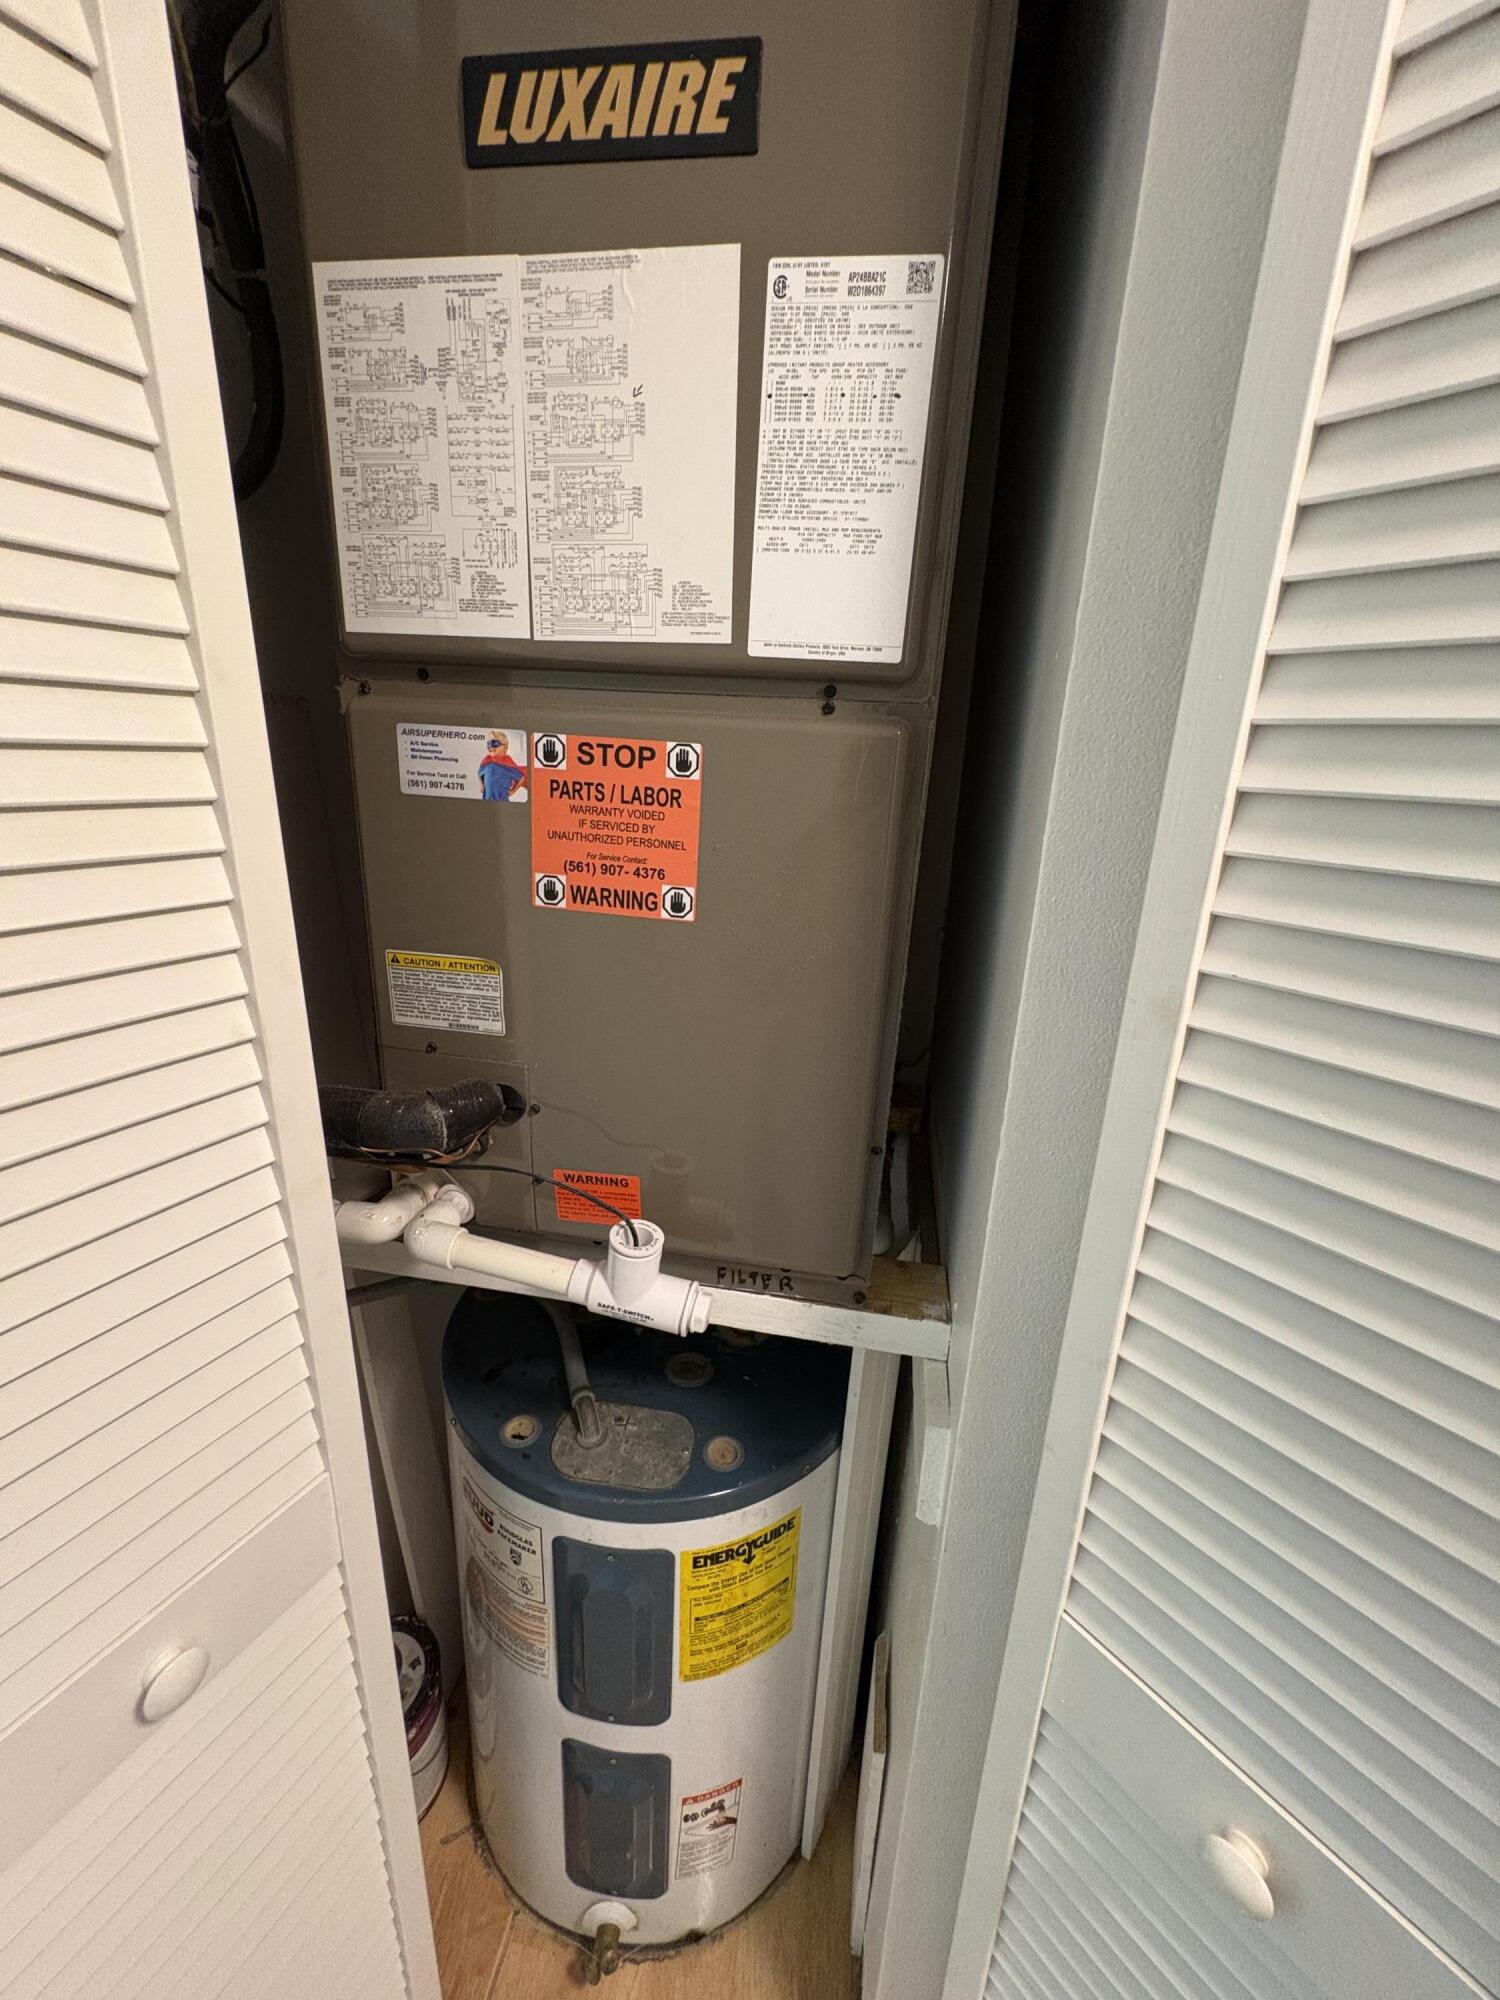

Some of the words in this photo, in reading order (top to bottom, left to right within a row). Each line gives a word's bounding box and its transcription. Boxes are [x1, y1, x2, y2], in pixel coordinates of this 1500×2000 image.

[477, 57, 748, 146] LUXAIRE
[401, 728, 485, 740] AIRSUPERHERO.com
[577, 742, 656, 769] STOP
[407, 779, 427, 789] (561)
[430, 781, 464, 790] 907-4376
[550, 779, 605, 802] PARTS
[621, 785, 682, 808] LABOR
[569, 804, 625, 818] WARRANTY
[627, 808, 665, 821] VOIDED
[578, 819, 588, 829] IF
[590, 820, 639, 834] SERVICED
[642, 823, 655, 835] BY
[548, 830, 624, 845] UNAUTHORIZED
[627, 837, 687, 851] PERSONNEL
[586, 852, 598, 860] For
[598, 853, 621, 862] Service
[623, 855, 648, 864] Contact:
[564, 860, 596, 877] (561)
[633, 868, 666, 881] 4376
[570, 885, 658, 912] WARNING
[403, 957, 441, 968] CAUTION
[448, 960, 496, 972] ATTENTION
[563, 1173, 629, 1187] WARNING
[717, 1266, 794, 1292] FILTER
[692, 1516, 796, 1569] ENERGYGUIDE
